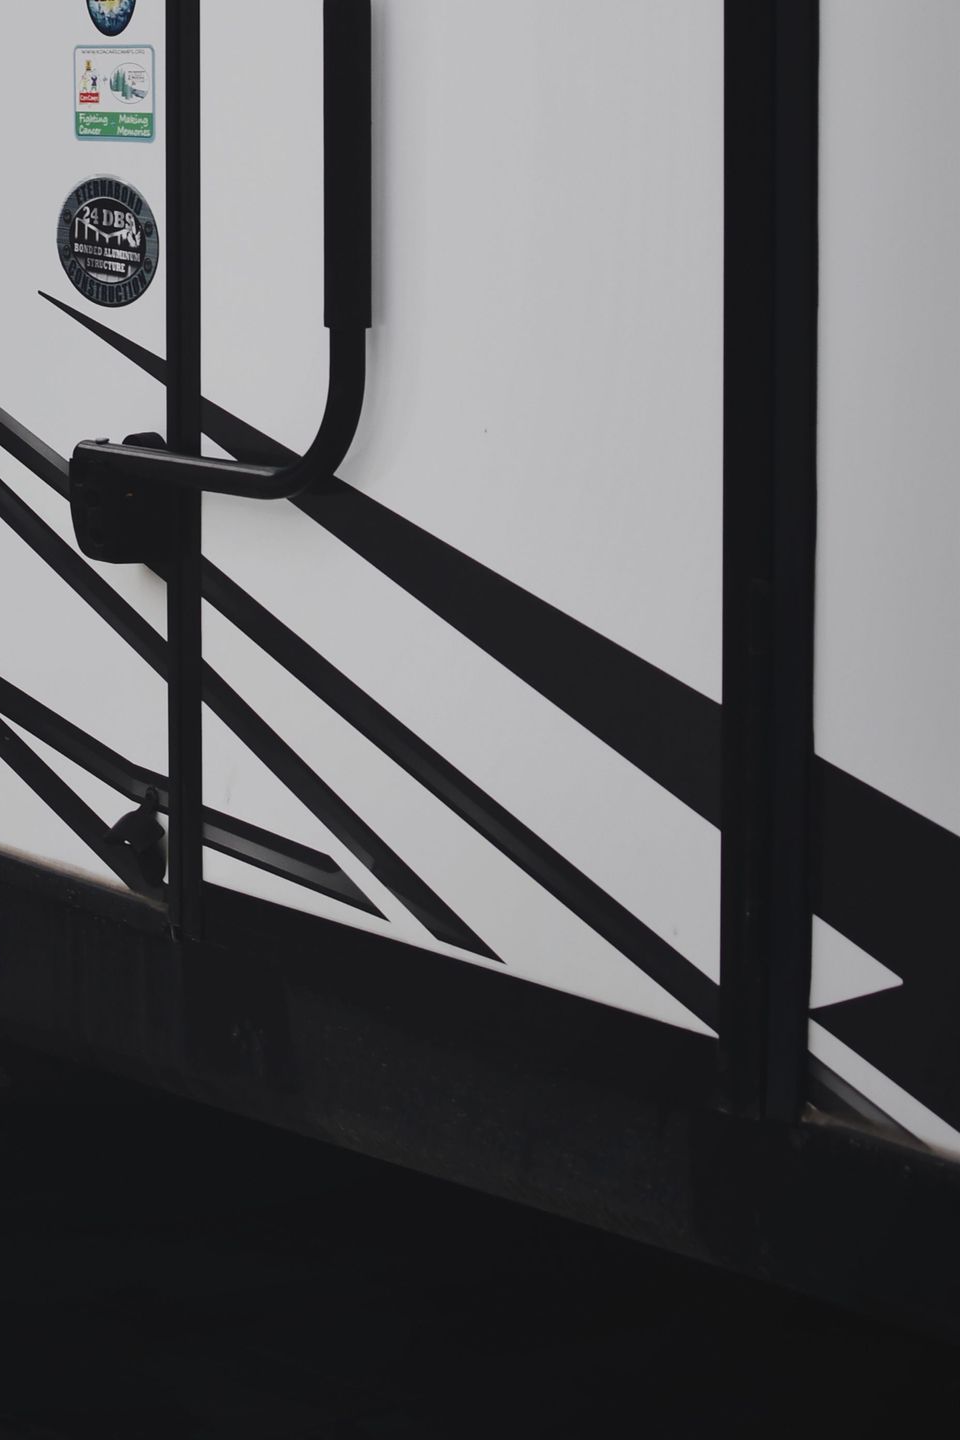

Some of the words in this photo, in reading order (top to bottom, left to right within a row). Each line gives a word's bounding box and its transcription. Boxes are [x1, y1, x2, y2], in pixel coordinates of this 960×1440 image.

[78, 113, 108, 126] Fighting
[119, 114, 149, 127] Making
[78, 125, 102, 136] Cancer
[117, 126, 151, 137] Memories
[76, 178, 143, 216] ETERNABOND
[82, 205, 99, 225] 24
[74, 242, 103, 257] BONDED
[103, 247, 141, 263] ALUMINUM
[86, 257, 126, 273] STRUCTURE
[68, 259, 146, 303] CONSTRUCTION
